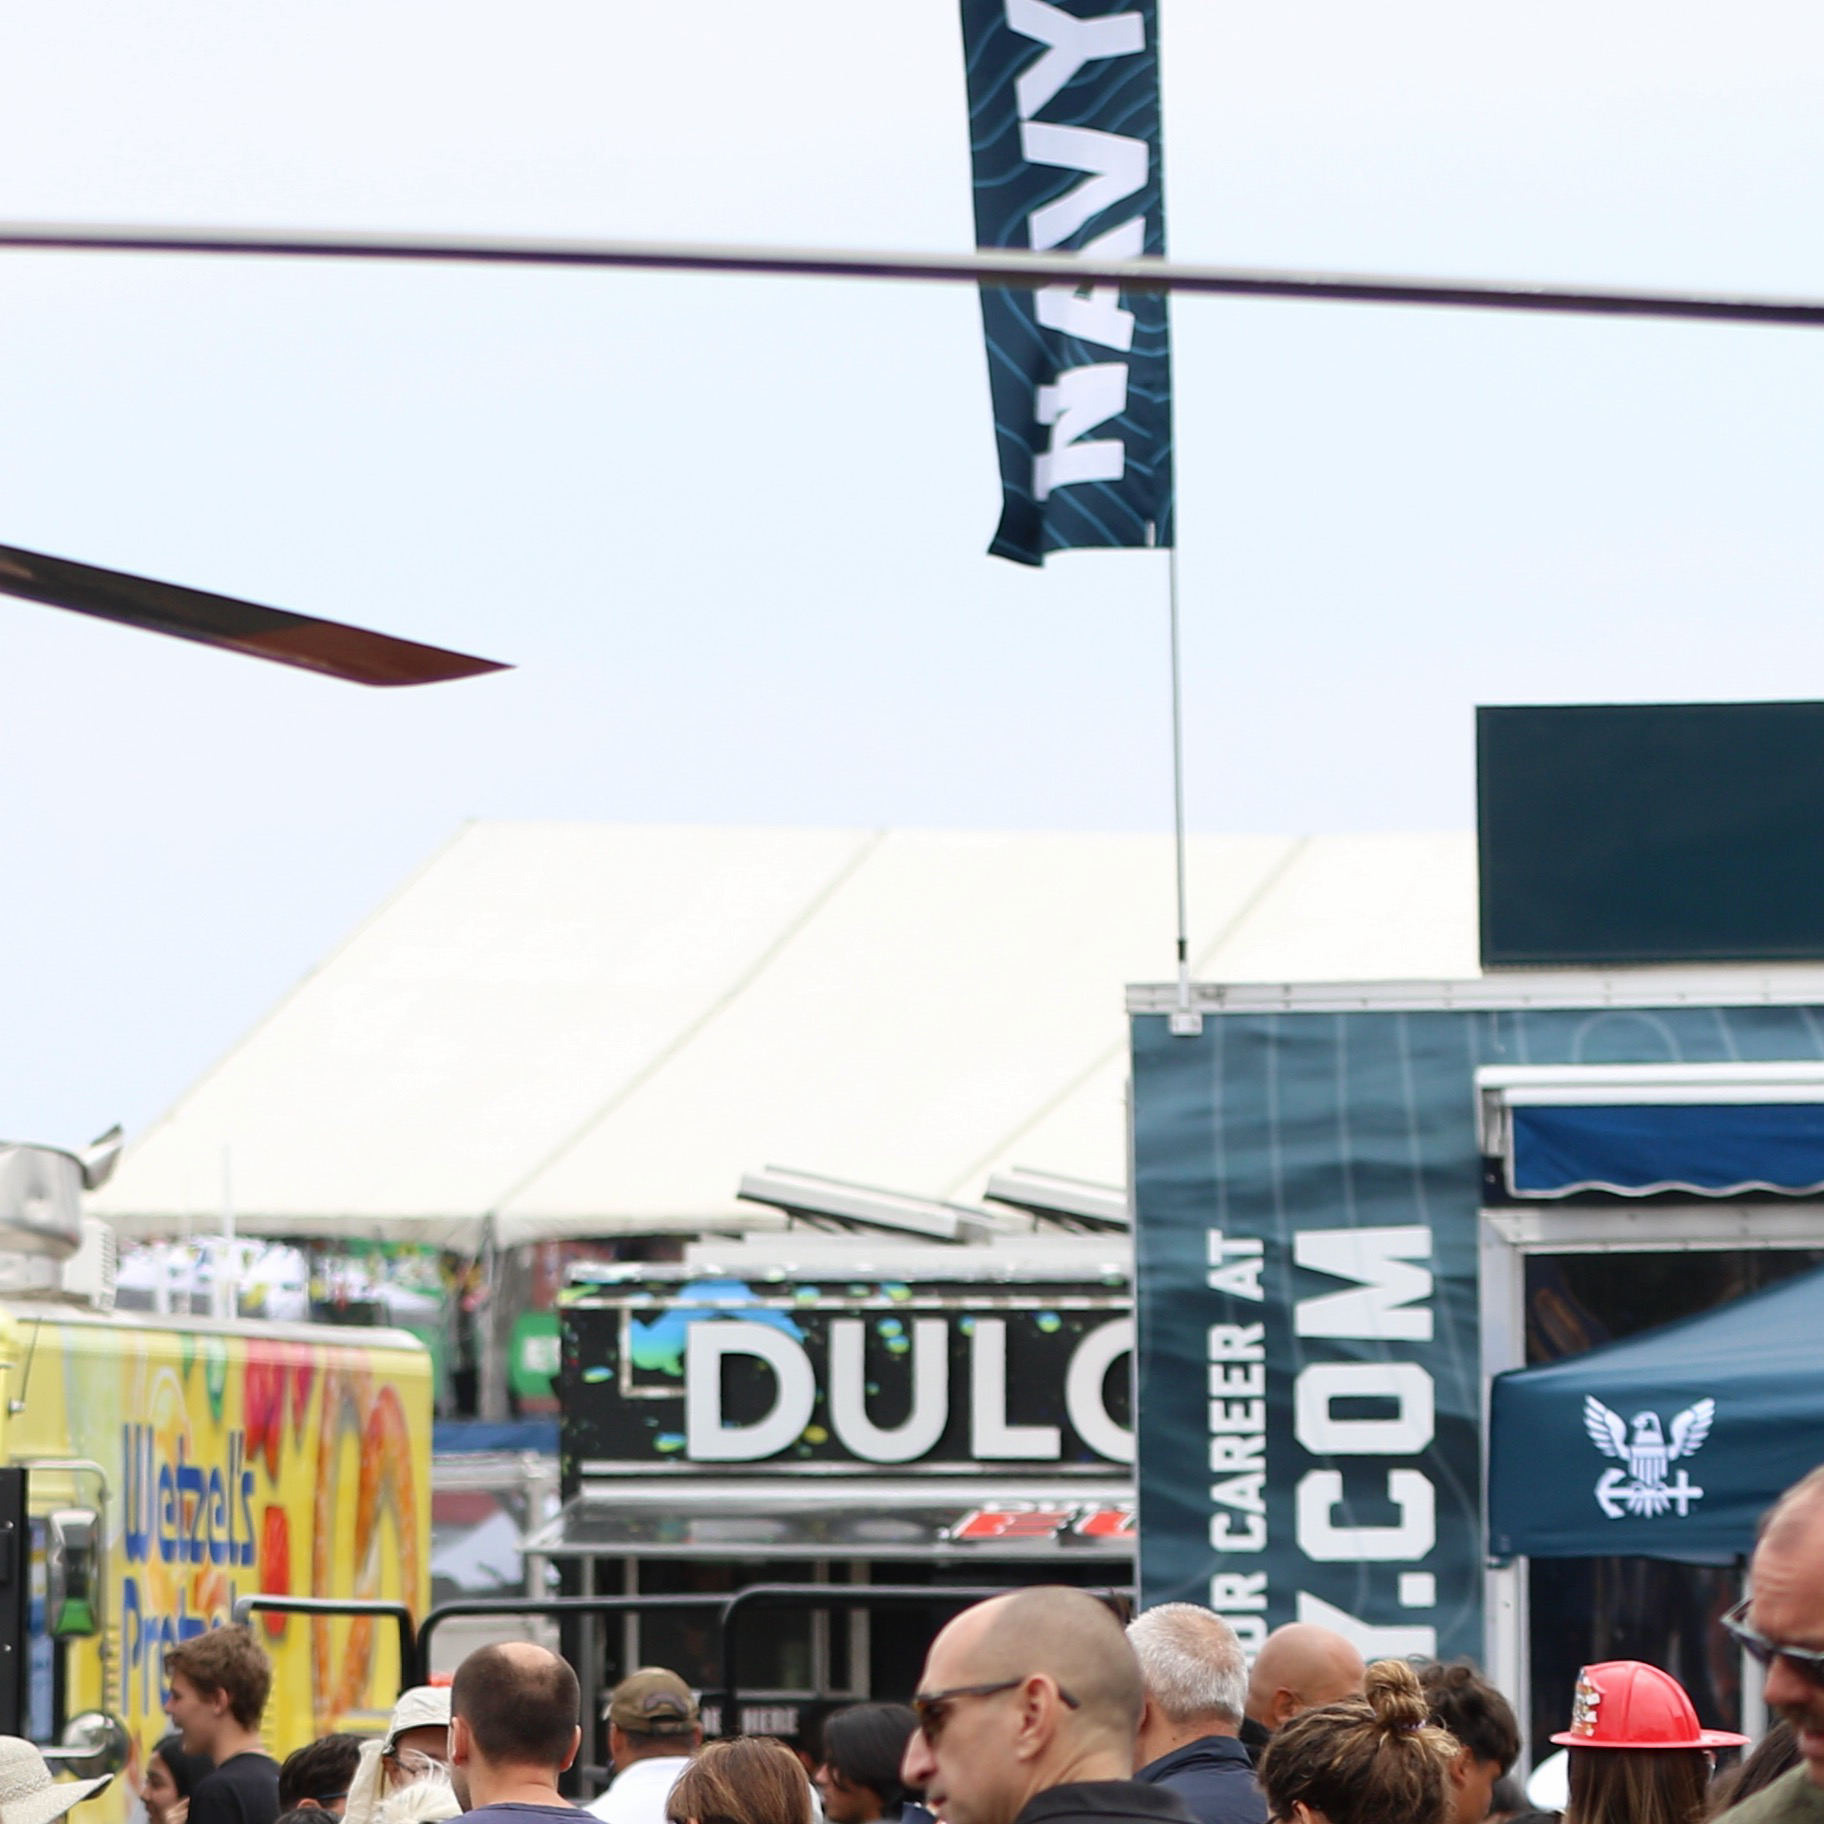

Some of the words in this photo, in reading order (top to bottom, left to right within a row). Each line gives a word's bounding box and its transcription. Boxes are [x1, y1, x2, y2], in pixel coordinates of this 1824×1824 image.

[1006, 0, 1150, 501] NAVY
[1206, 1228, 1264, 1302] AT
[122, 1423, 257, 1566] Wetzel's
[1208, 1322, 1268, 1553] CAREER
